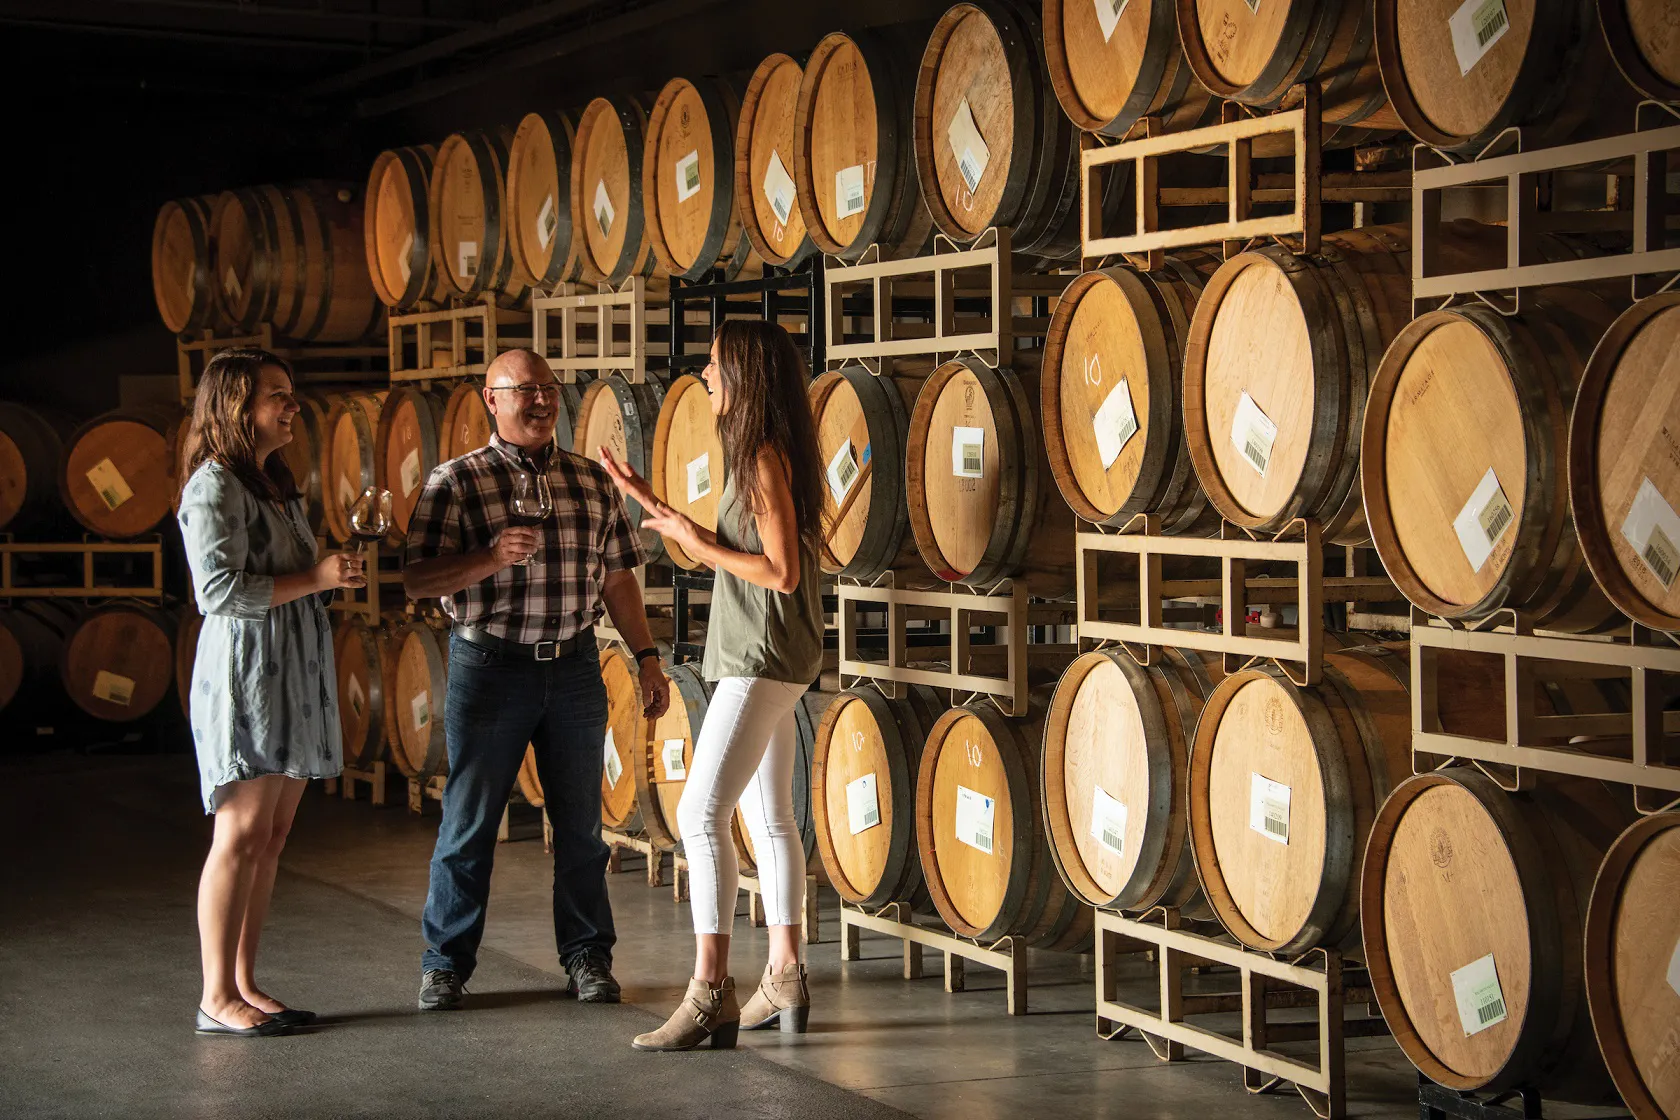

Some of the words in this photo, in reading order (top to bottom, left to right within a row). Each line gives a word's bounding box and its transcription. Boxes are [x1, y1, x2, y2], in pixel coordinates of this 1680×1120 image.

[955, 184, 973, 211] 10
[1084, 353, 1101, 386] 10
[965, 739, 981, 768] 10
